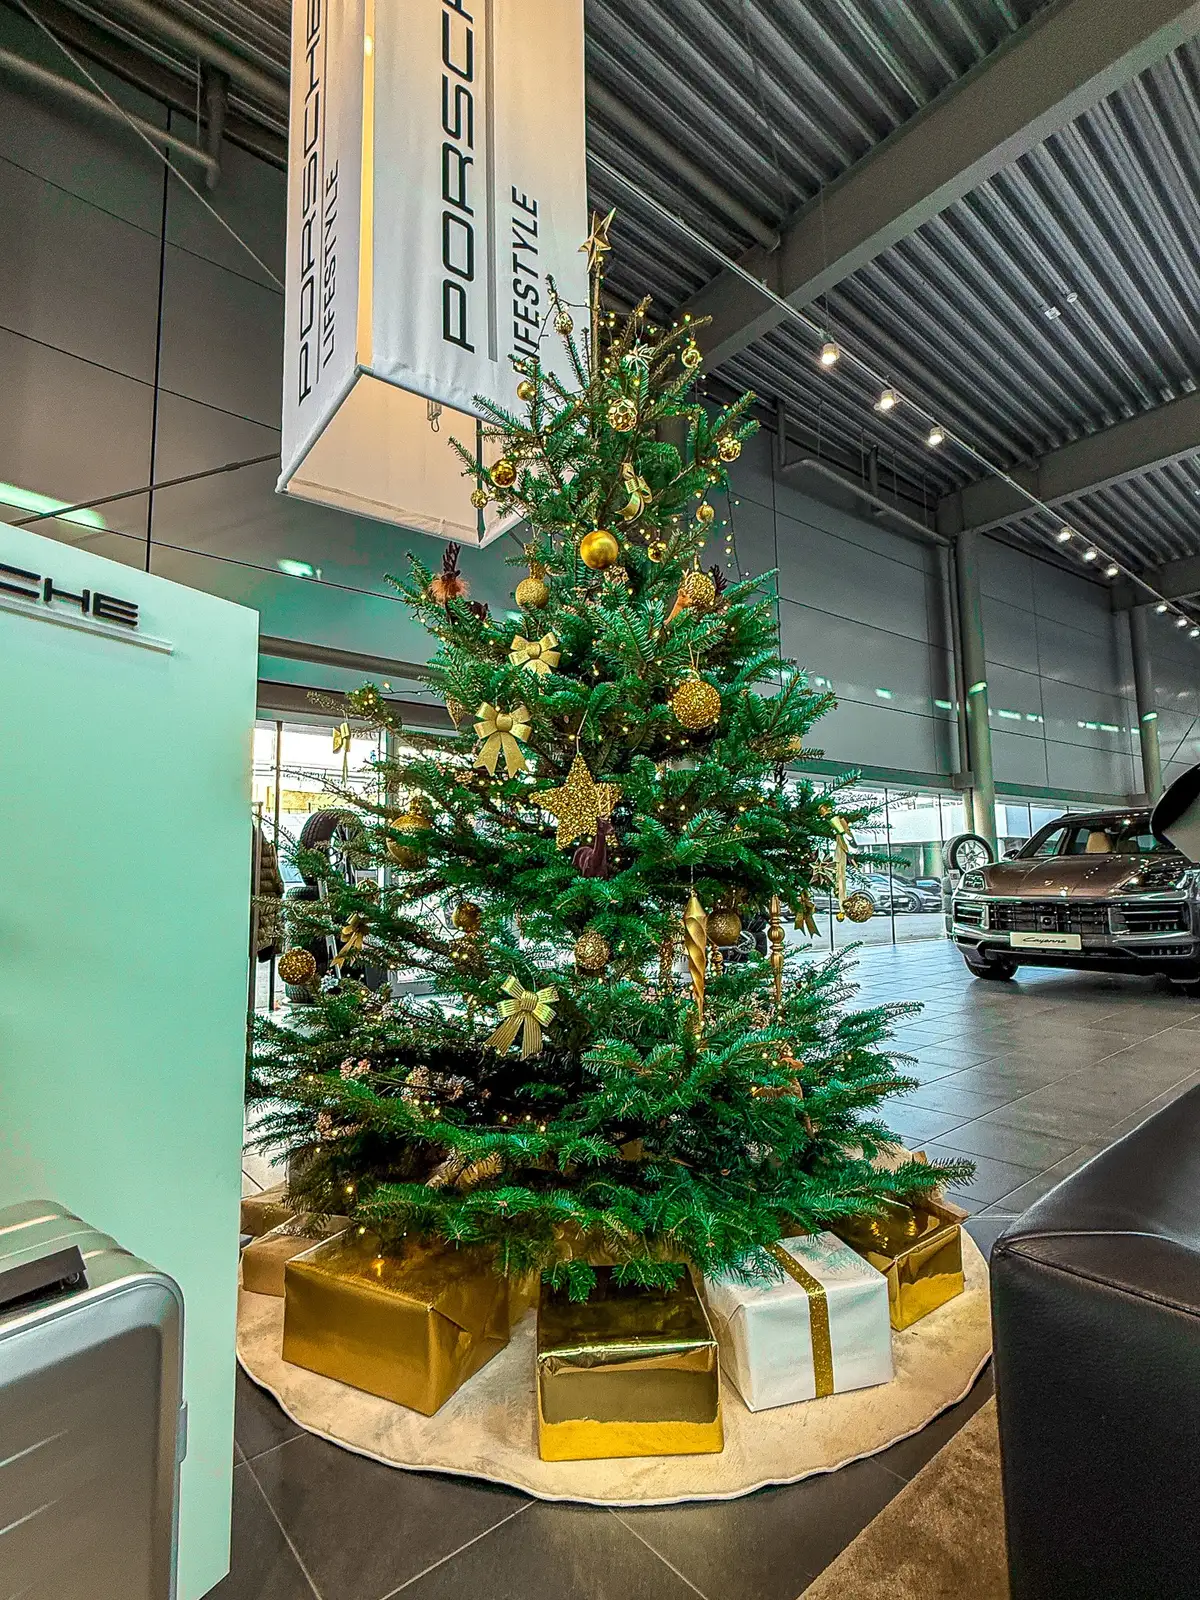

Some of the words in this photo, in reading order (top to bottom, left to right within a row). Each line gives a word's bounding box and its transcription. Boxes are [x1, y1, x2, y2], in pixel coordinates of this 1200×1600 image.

[299, 0, 320, 406] PORSCHE
[323, 159, 338, 369] LIFESTYLE
[1022, 936, 1068, 945] Cayenne
